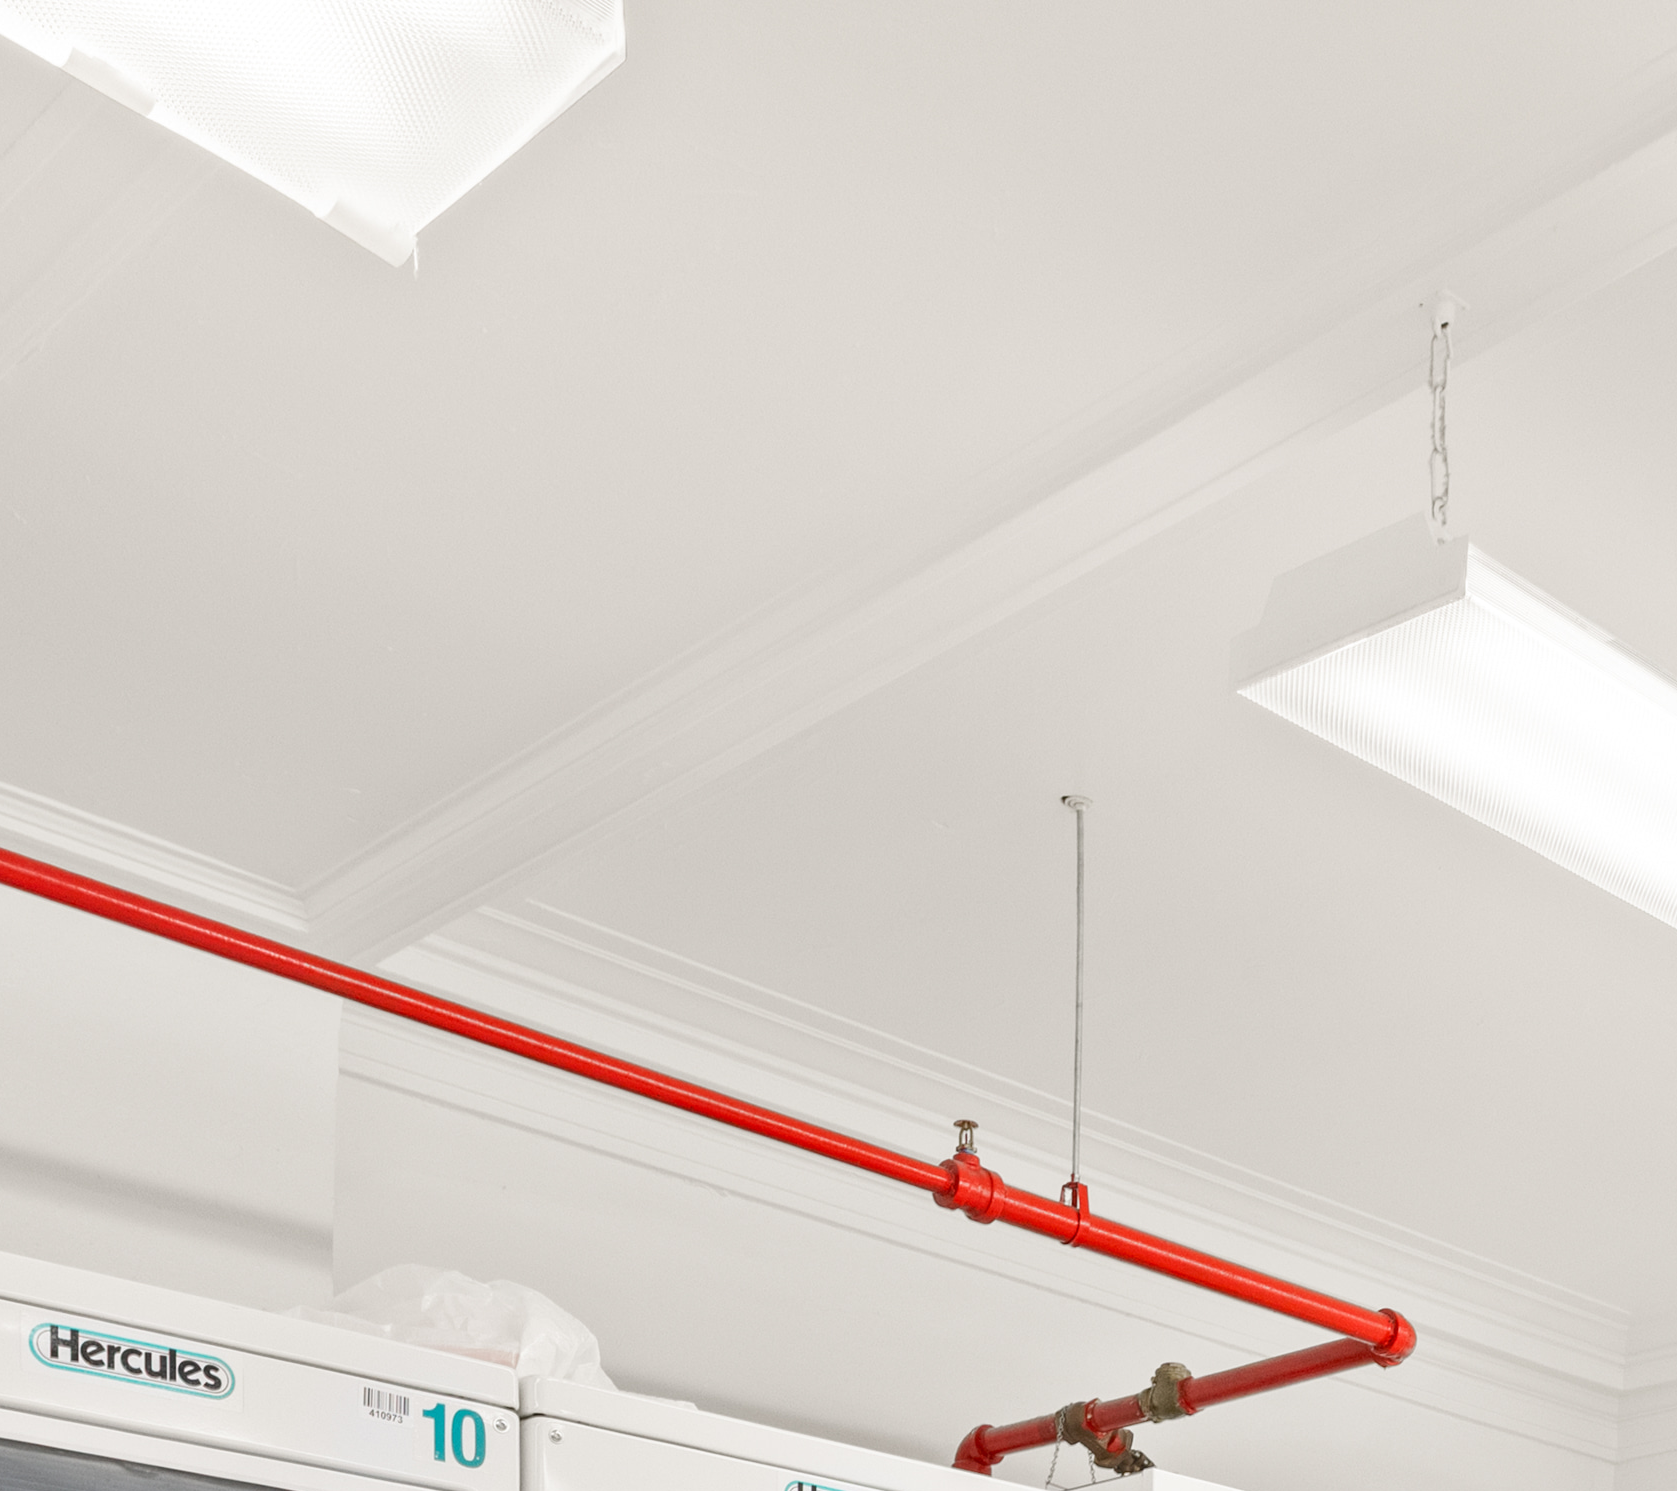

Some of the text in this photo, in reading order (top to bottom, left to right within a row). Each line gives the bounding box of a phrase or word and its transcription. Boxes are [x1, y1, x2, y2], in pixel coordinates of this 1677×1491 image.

[49, 1324, 222, 1394] Hercules
[369, 1407, 404, 1424] 410973
[422, 1401, 487, 1469] 10
